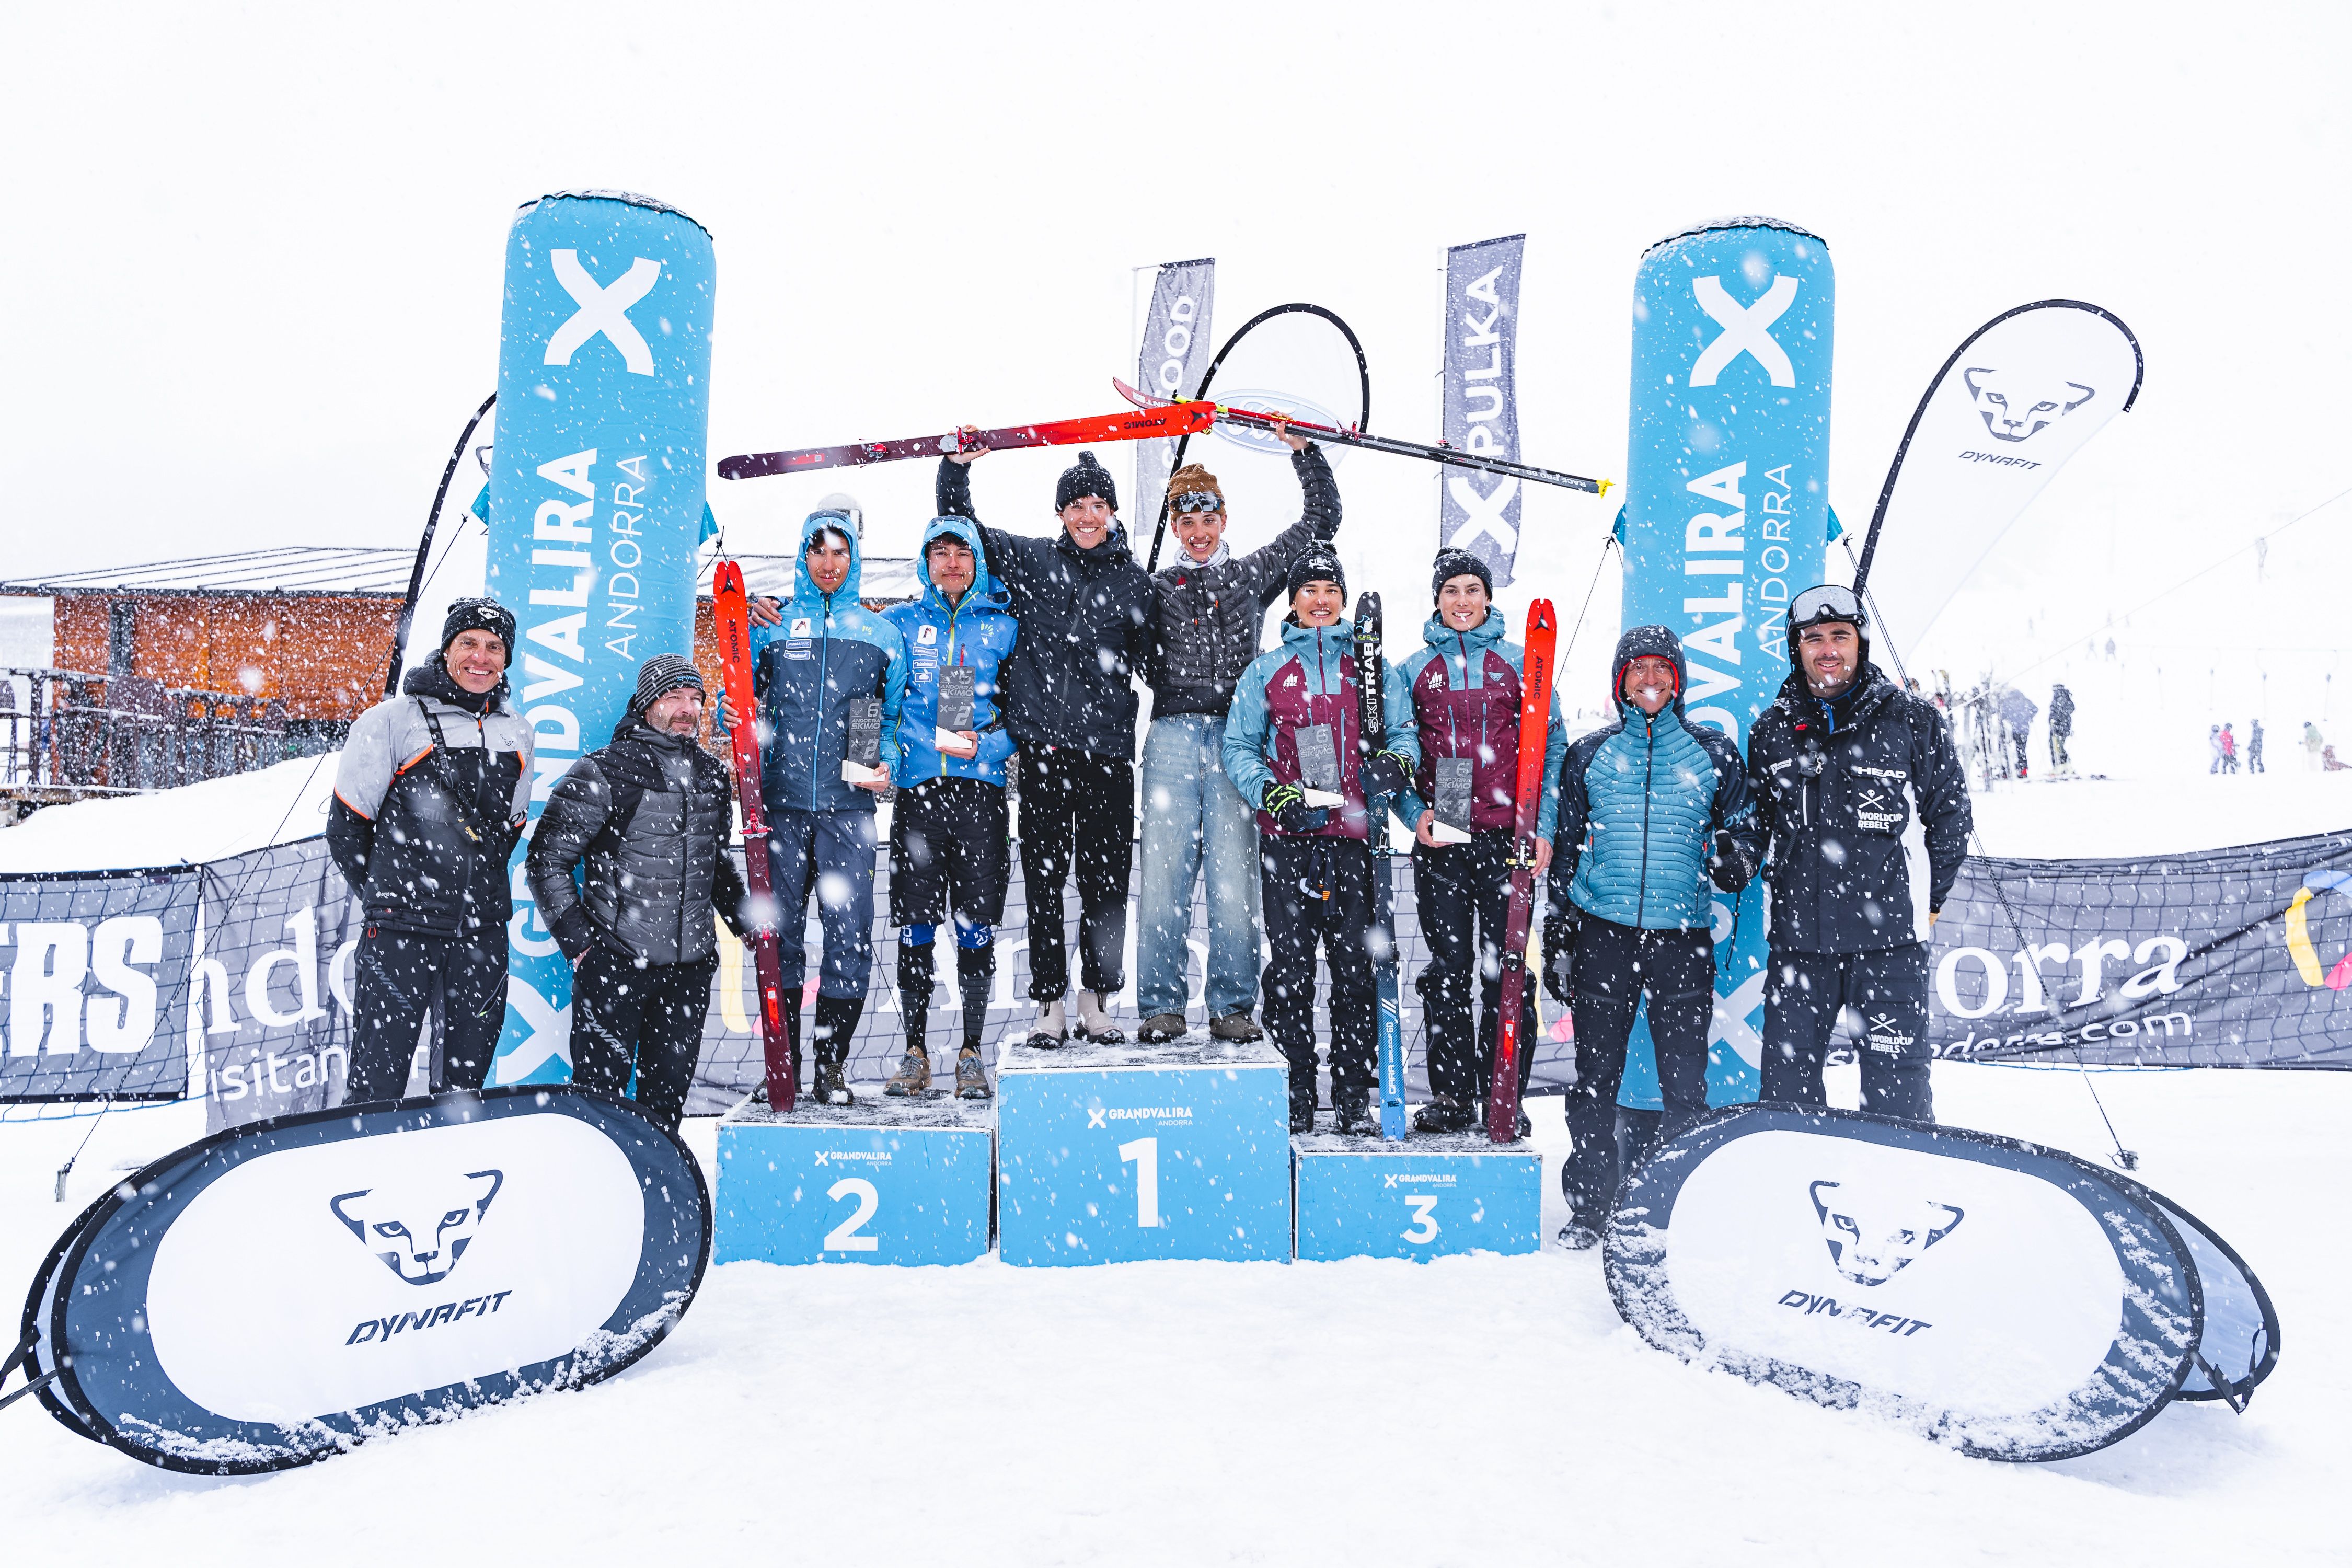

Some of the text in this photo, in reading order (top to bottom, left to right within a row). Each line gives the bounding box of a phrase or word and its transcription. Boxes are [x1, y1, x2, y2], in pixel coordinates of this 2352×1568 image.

[1465, 264, 1505, 458] PULKA
[1123, 417, 1167, 429] ATOMIC
[1958, 451, 2042, 470] DYNAFIT
[1540, 472, 1560, 482] PRO
[1561, 476, 1587, 487] RACE
[605, 455, 648, 661] ANDORRA
[1759, 463, 1793, 662] ANDORRA
[728, 619, 740, 664] ATOMIC
[1428, 682, 1443, 690] FEEC
[1533, 656, 1543, 700] ATOMIC
[940, 688, 974, 697] SKIMO
[1363, 642, 1379, 733] SKITRAB
[868, 702, 879, 717] 6
[953, 705, 972, 726] 2
[1316, 728, 1328, 743] 6
[863, 737, 879, 759] 2
[1456, 762, 1470, 777] 6
[1857, 767, 1907, 779] HEAD
[1858, 810, 1904, 822] WORLDCUP
[1858, 820, 1890, 830] REBELS
[364, 954, 414, 1011] DYNAFIT
[584, 1006, 632, 1064] DYNAFIT
[1871, 1034, 1915, 1046] WORLDCUP
[1871, 1042, 1901, 1054] REBELS
[1388, 1064, 1396, 1095] GARA
[1108, 1107, 1193, 1120] GRANDVALIRA
[830, 1151, 892, 1161] GRANDVALIRA
[1117, 1137, 1159, 1228] 1
[1399, 1174, 1457, 1183] GRANDVALIRA
[824, 1177, 879, 1251] 2
[1401, 1195, 1438, 1244] 3
[345, 1289, 513, 1346] DYNAFIT
